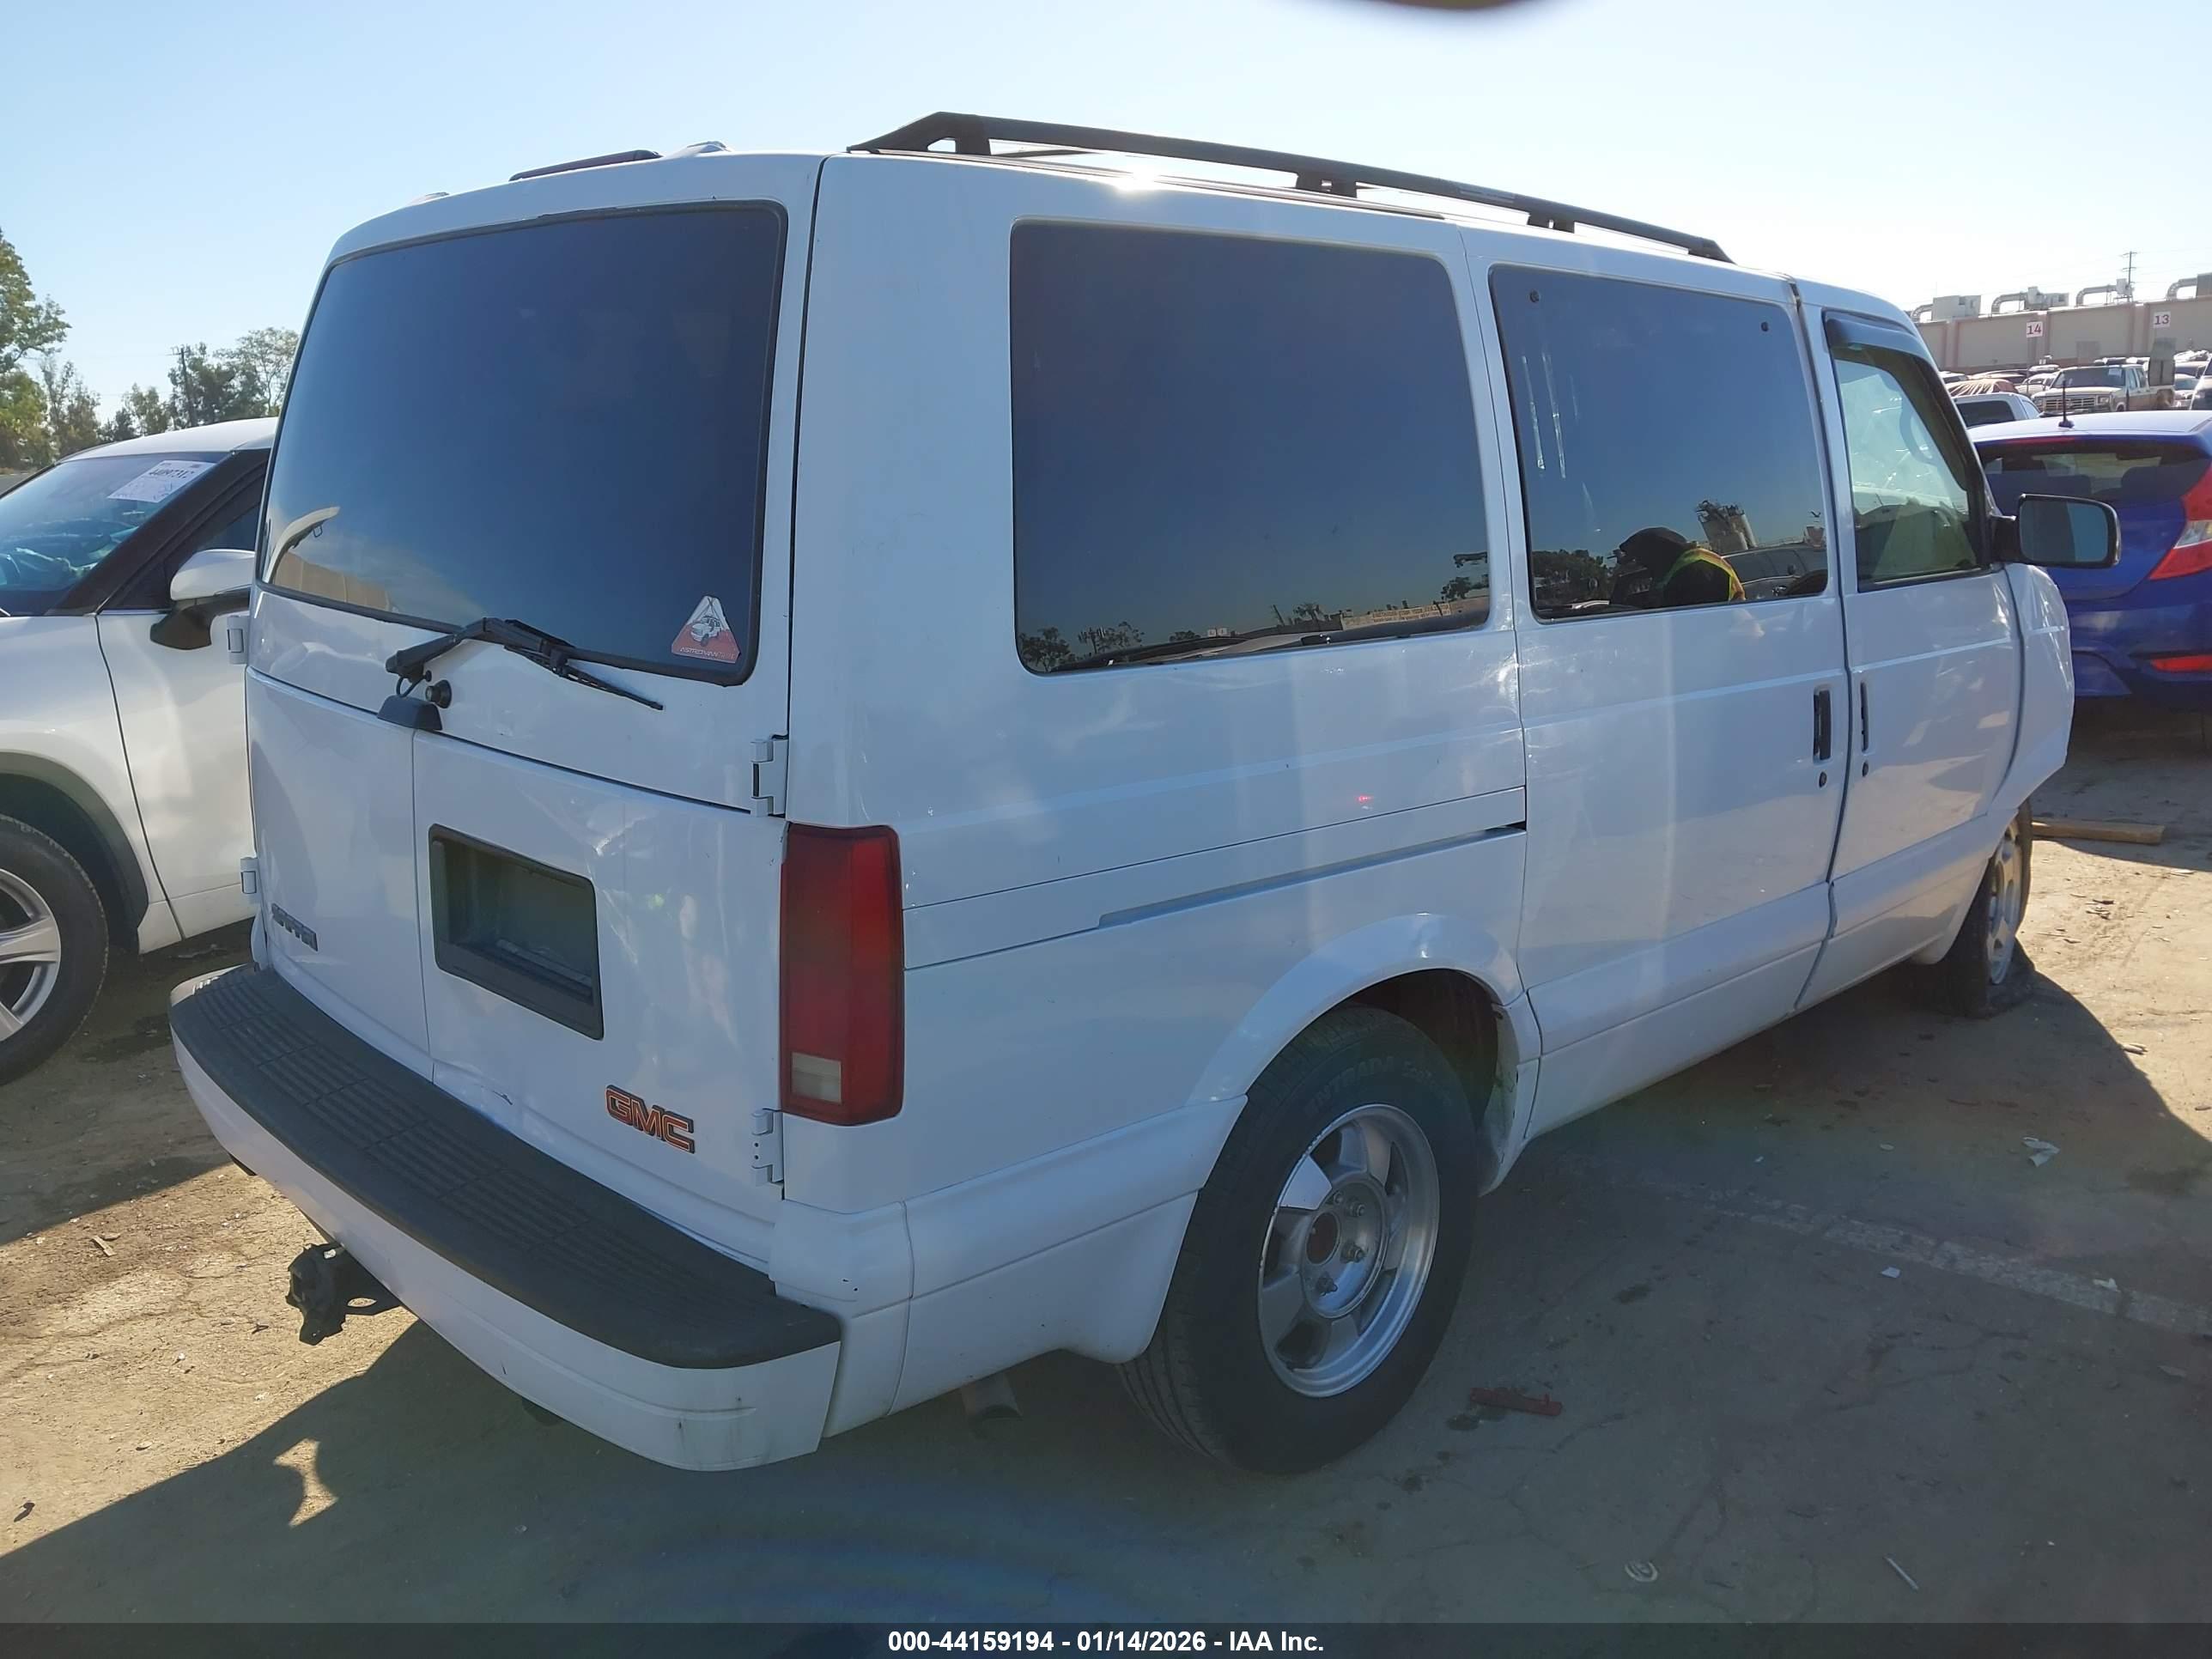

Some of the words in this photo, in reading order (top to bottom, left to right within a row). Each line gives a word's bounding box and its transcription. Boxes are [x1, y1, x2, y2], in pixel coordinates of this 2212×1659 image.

[2154, 314, 2170, 325] 13
[2027, 324, 2042, 335] 14
[605, 1085, 696, 1154] GMC
